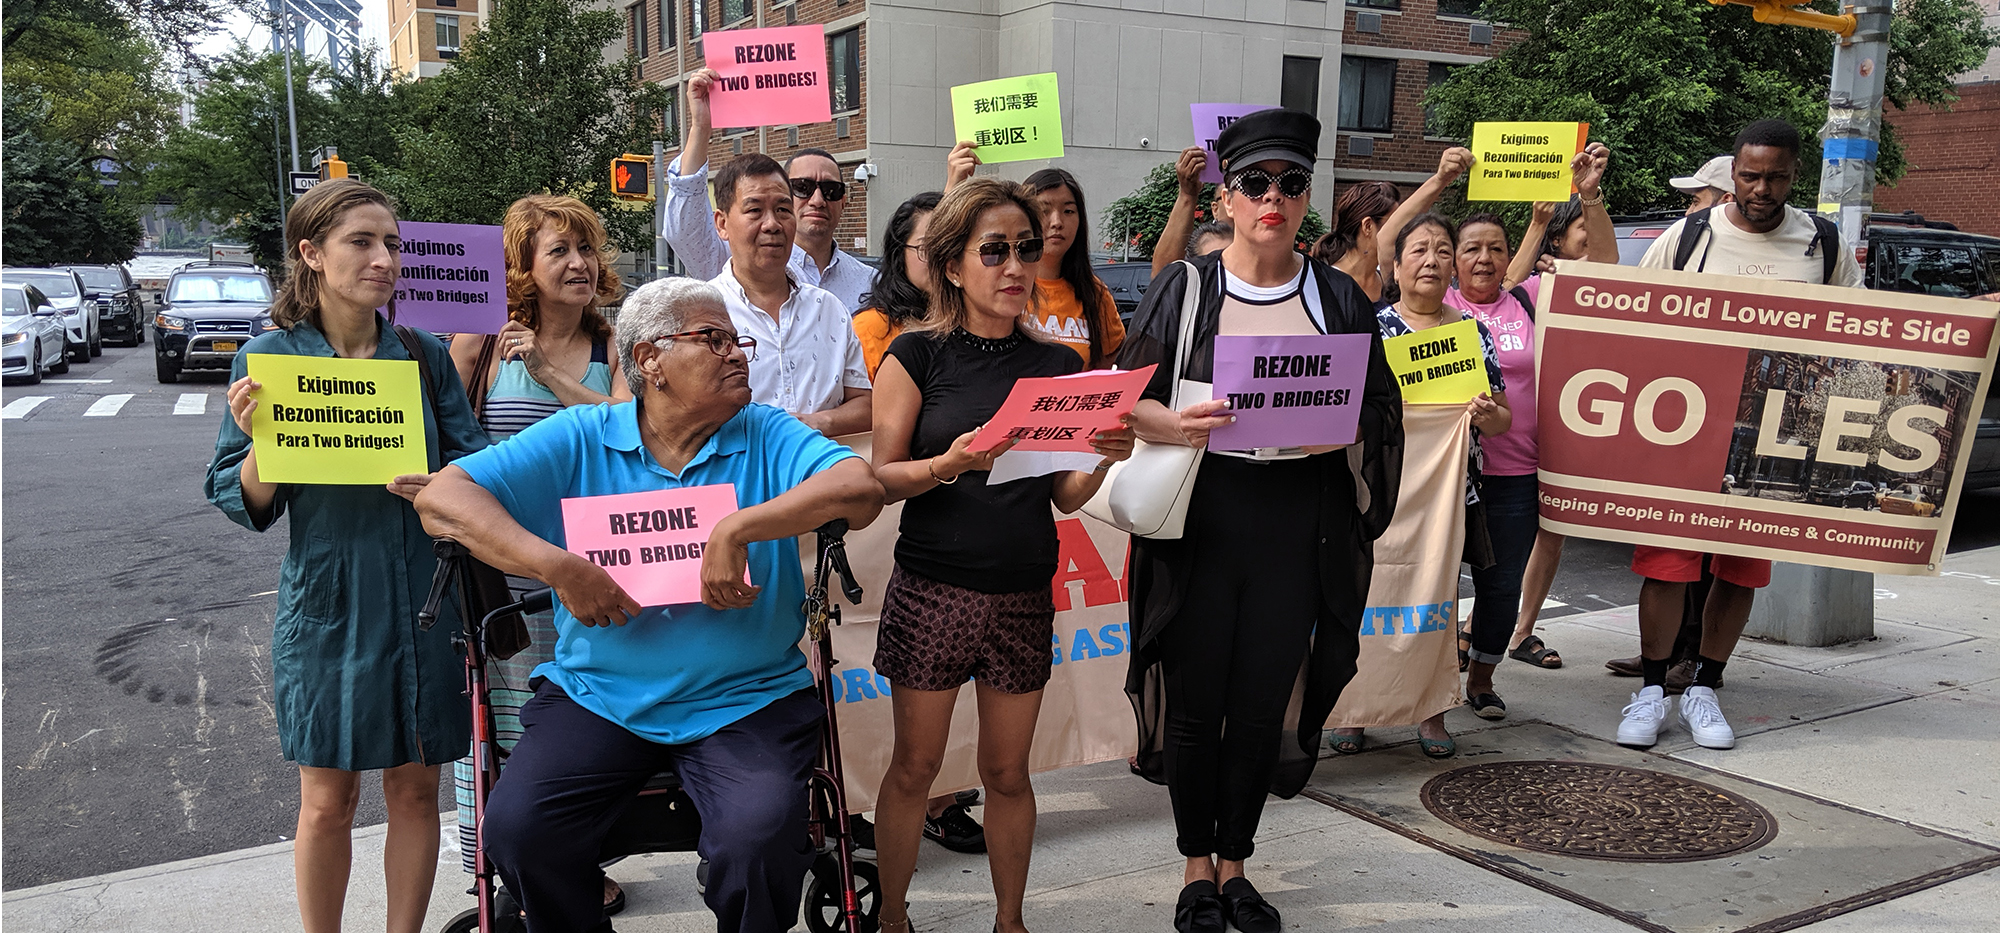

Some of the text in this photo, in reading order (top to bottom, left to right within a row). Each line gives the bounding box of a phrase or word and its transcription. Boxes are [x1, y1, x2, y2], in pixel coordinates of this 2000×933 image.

[735, 42, 796, 64] REZONE
[720, 72, 817, 92] TWO BRIDGES!
[974, 92, 1038, 114] 我们需要
[1501, 134, 1549, 146] Exigimos
[1484, 152, 1563, 164] Rezonificación
[1484, 169, 1560, 180] Para Two Bridges!
[400, 265, 489, 282] onificación
[1738, 264, 1778, 275] LOVE
[394, 288, 489, 304] ra Two Bridges!
[1574, 286, 1970, 346] Good Old Lower East Side
[1409, 336, 1458, 362] REZONE
[1500, 334, 1524, 352] 39
[1253, 354, 1332, 378] REZONE
[1398, 358, 1476, 386] TWO BRIDGES!
[298, 376, 376, 396] Exigimos
[1030, 390, 1124, 412] 我们需要
[1227, 388, 1350, 410] TWO BRIDGES!
[273, 404, 404, 424] Rezonificación
[1558, 368, 1949, 474] GO LES
[276, 433, 404, 450] Para Two Bridges!
[609, 506, 698, 535] REZONE
[1604, 502, 1663, 521] People
[1668, 509, 1685, 523] in
[1690, 512, 1734, 529] their
[1738, 518, 1800, 538] Homes
[1804, 526, 1818, 540] &
[1824, 528, 1925, 554] Community
[586, 548, 631, 566] TWO
